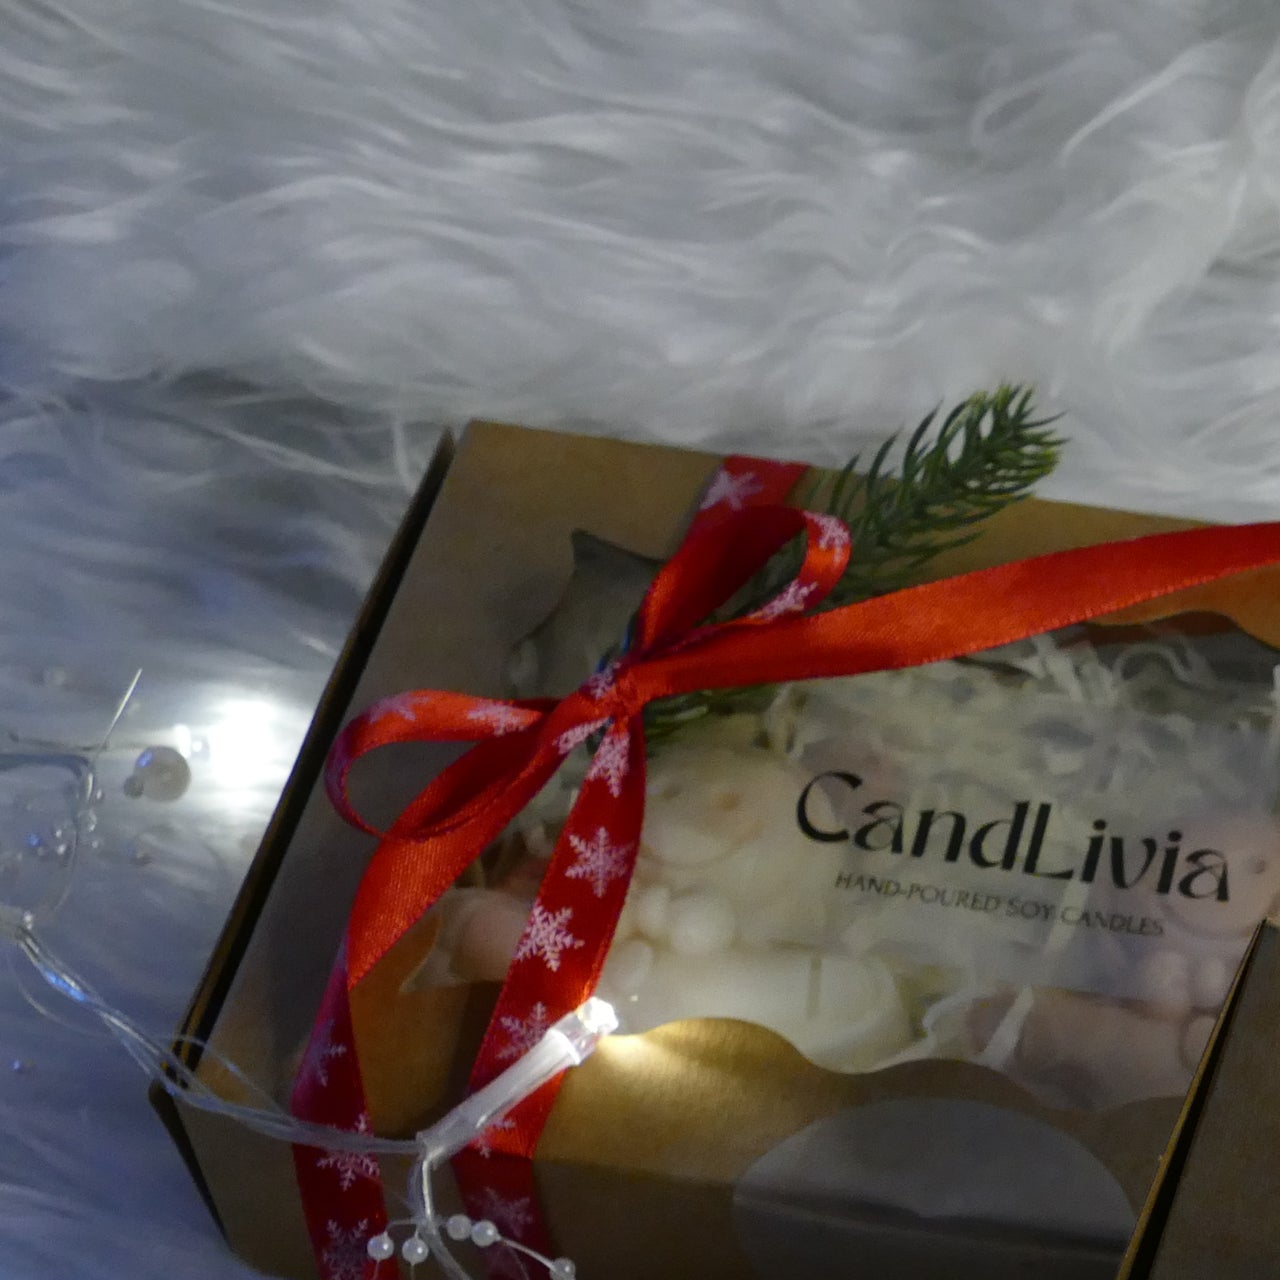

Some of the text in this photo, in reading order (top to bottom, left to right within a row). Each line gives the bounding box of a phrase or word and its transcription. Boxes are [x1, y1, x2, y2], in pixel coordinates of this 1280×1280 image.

[797, 770, 1230, 902] CandLivia
[834, 872, 1165, 937] HAND-POURED SOY CANDLES
